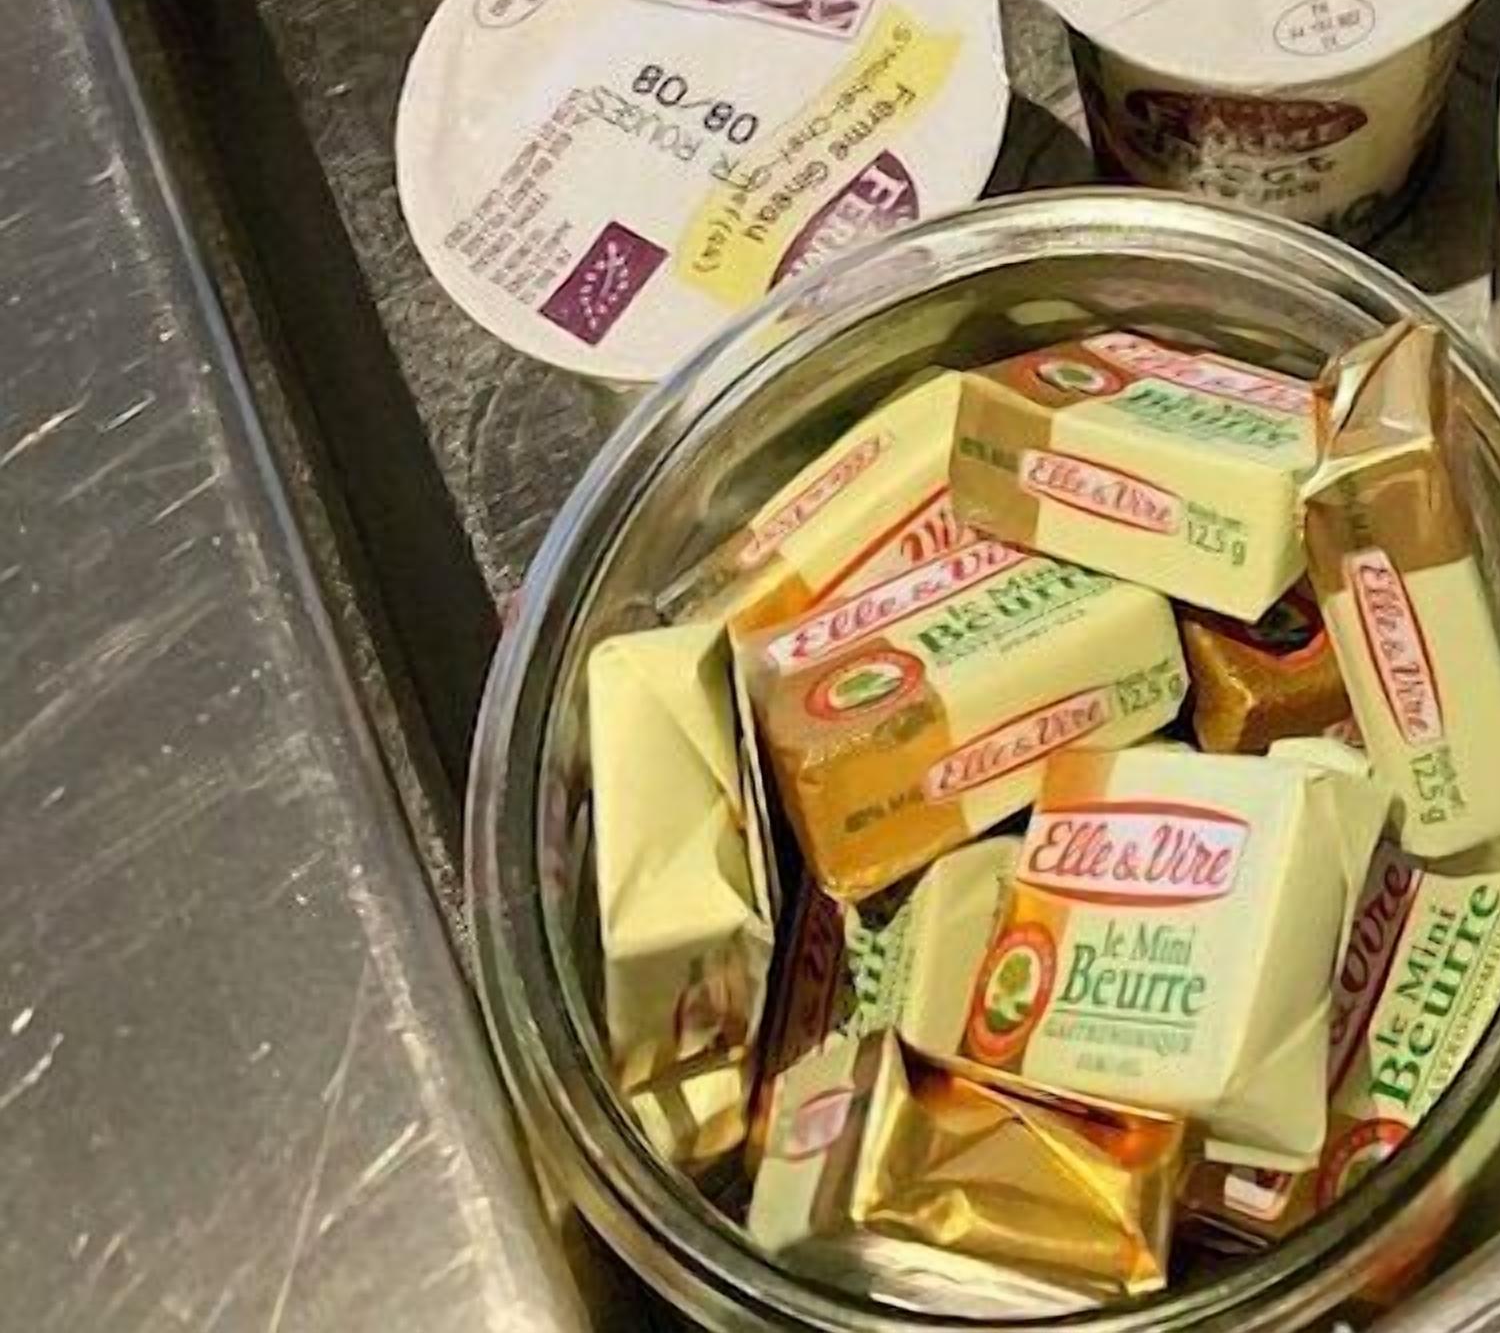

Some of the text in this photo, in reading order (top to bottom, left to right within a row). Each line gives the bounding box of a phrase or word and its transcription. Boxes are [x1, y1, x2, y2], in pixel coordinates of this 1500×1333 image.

[628, 59, 763, 148] 08/08
[824, 77, 912, 163] Ferme
[1029, 820, 1231, 887] Elle & Vire
[1060, 943, 1208, 1017] Beurre
[1101, 918, 1198, 966] le Mini
[1376, 903, 1456, 1047] le Mini
